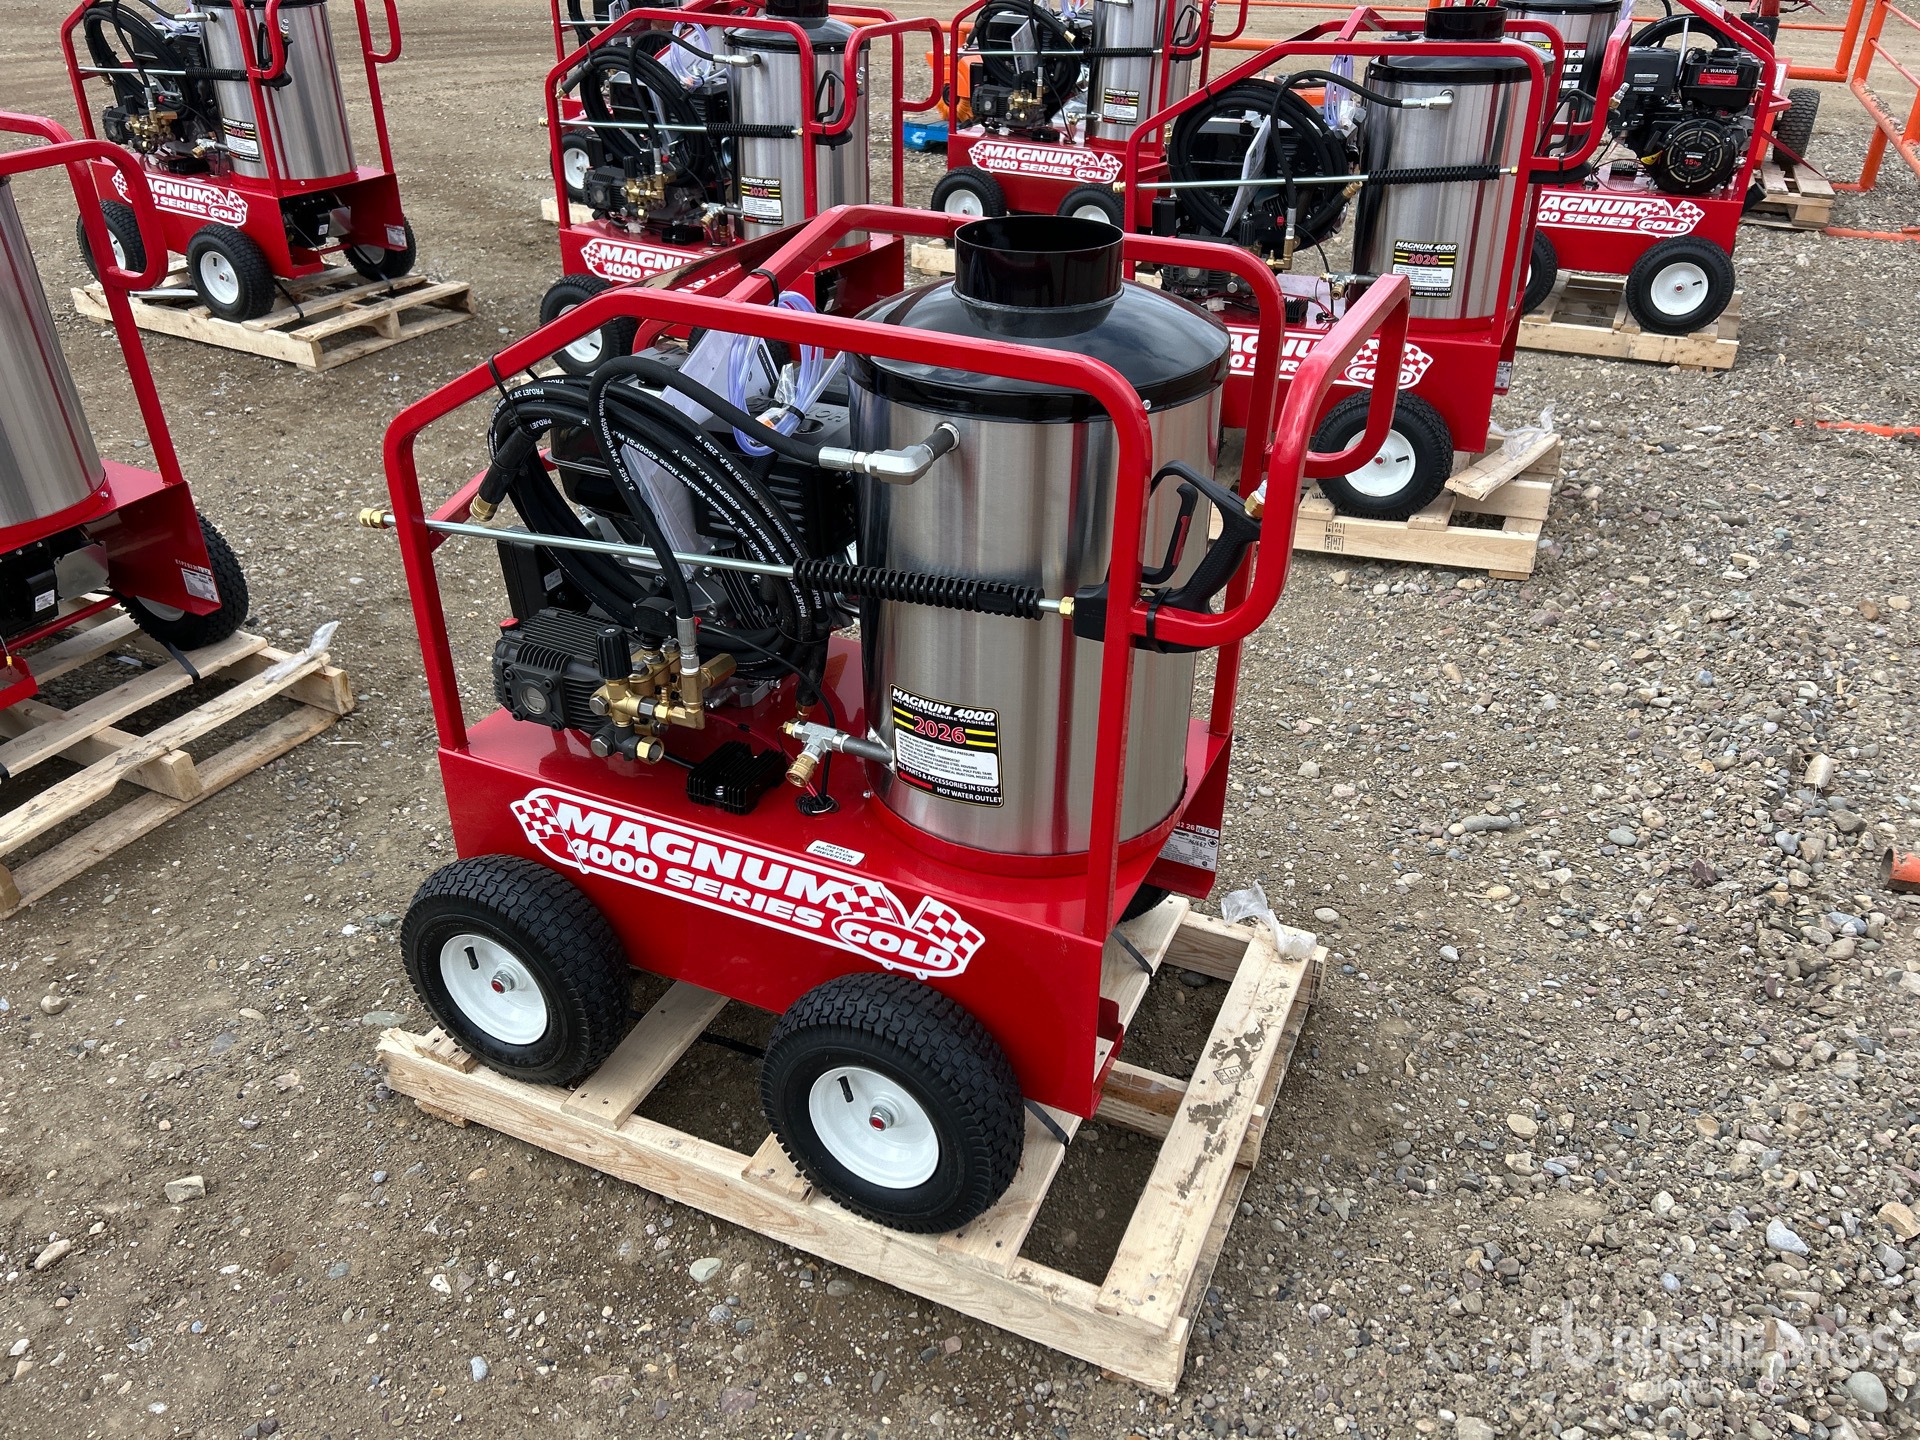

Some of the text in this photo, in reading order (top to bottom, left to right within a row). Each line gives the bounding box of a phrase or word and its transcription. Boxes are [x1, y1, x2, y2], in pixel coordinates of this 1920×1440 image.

[985, 144, 1080, 165] MAGNUM
[987, 158, 1072, 175] 4000 SERIES
[1076, 170, 1112, 180] GOLD
[160, 196, 206, 213] SERIES
[210, 208, 241, 220] GOLD
[1540, 196, 1648, 217] AGNUM
[1562, 215, 1635, 227] SERIES
[1640, 220, 1688, 231] GOLD
[1396, 242, 1434, 250] MAGNUM
[1408, 253, 1439, 265] 2026
[604, 263, 641, 278] 4000
[601, 417, 614, 448] 4500PSI
[618, 467, 630, 483] 250
[626, 438, 658, 460] 4500PSI
[704, 442, 719, 456] 250
[659, 459, 679, 476] Hose
[681, 456, 696, 468] 250
[720, 455, 734, 471] W.P.
[679, 474, 706, 499] Washer
[732, 471, 759, 499] 4500PSI
[713, 483, 740, 510] 4500PSI
[706, 496, 736, 526] Pressure
[741, 510, 757, 527] Hose
[756, 528, 776, 553] Washer
[796, 595, 807, 618] PROJET
[893, 688, 995, 722] MAGNUM 4000
[903, 702, 923, 712] WATER
[924, 710, 957, 721] PRESSURE
[959, 718, 995, 726] WASHERS
[913, 715, 966, 744] 2026
[897, 762, 905, 770] ALL
[906, 766, 922, 777] PARTS
[928, 775, 967, 790] ACCESSORIES
[977, 785, 999, 793] STOCK
[937, 787, 1003, 803] HOT WATER OUTLET
[556, 802, 852, 906] MAGNUM
[813, 849, 852, 862] PREVENTER
[567, 838, 826, 929] 4000 SERIES
[839, 922, 953, 969] GOLD
